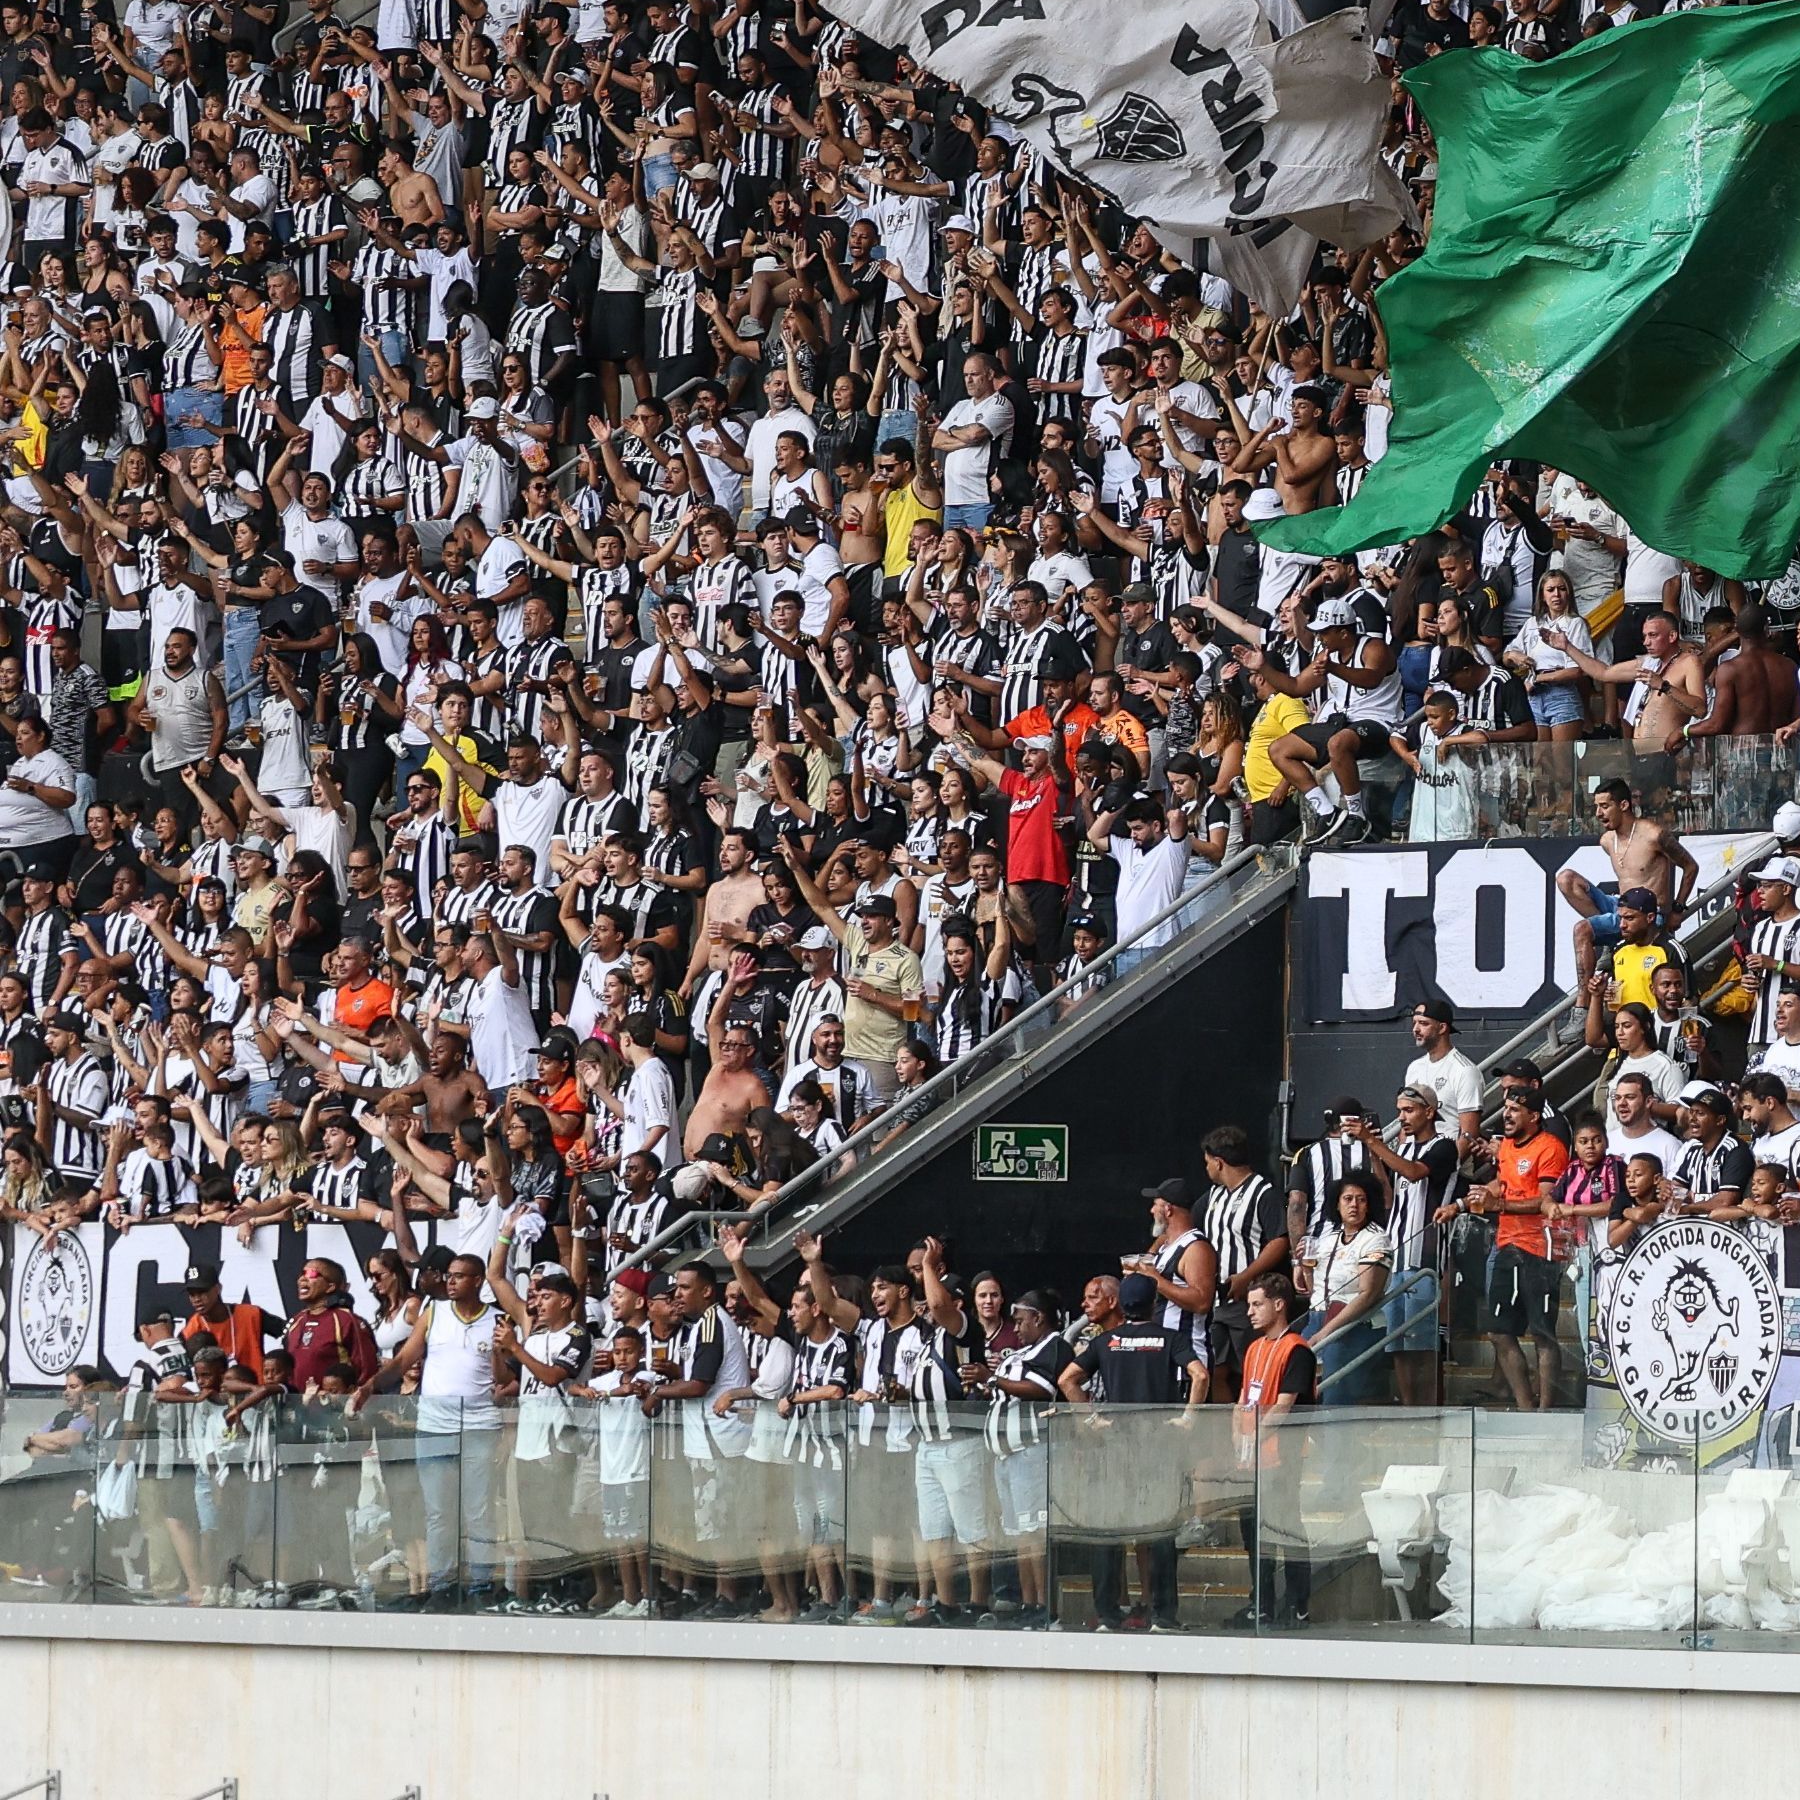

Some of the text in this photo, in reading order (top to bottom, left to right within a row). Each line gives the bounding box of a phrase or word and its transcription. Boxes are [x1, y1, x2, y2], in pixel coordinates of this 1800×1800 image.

[1103, 436, 1122, 450] H2
[1037, 1170, 1057, 1181] 1908
[1639, 1228, 1707, 1276] TORCIDA
[1709, 1229, 1777, 1341] ORGANIZADA
[1709, 1354, 1736, 1369] CAM
[1619, 1363, 1769, 1437] GALOUCURA
